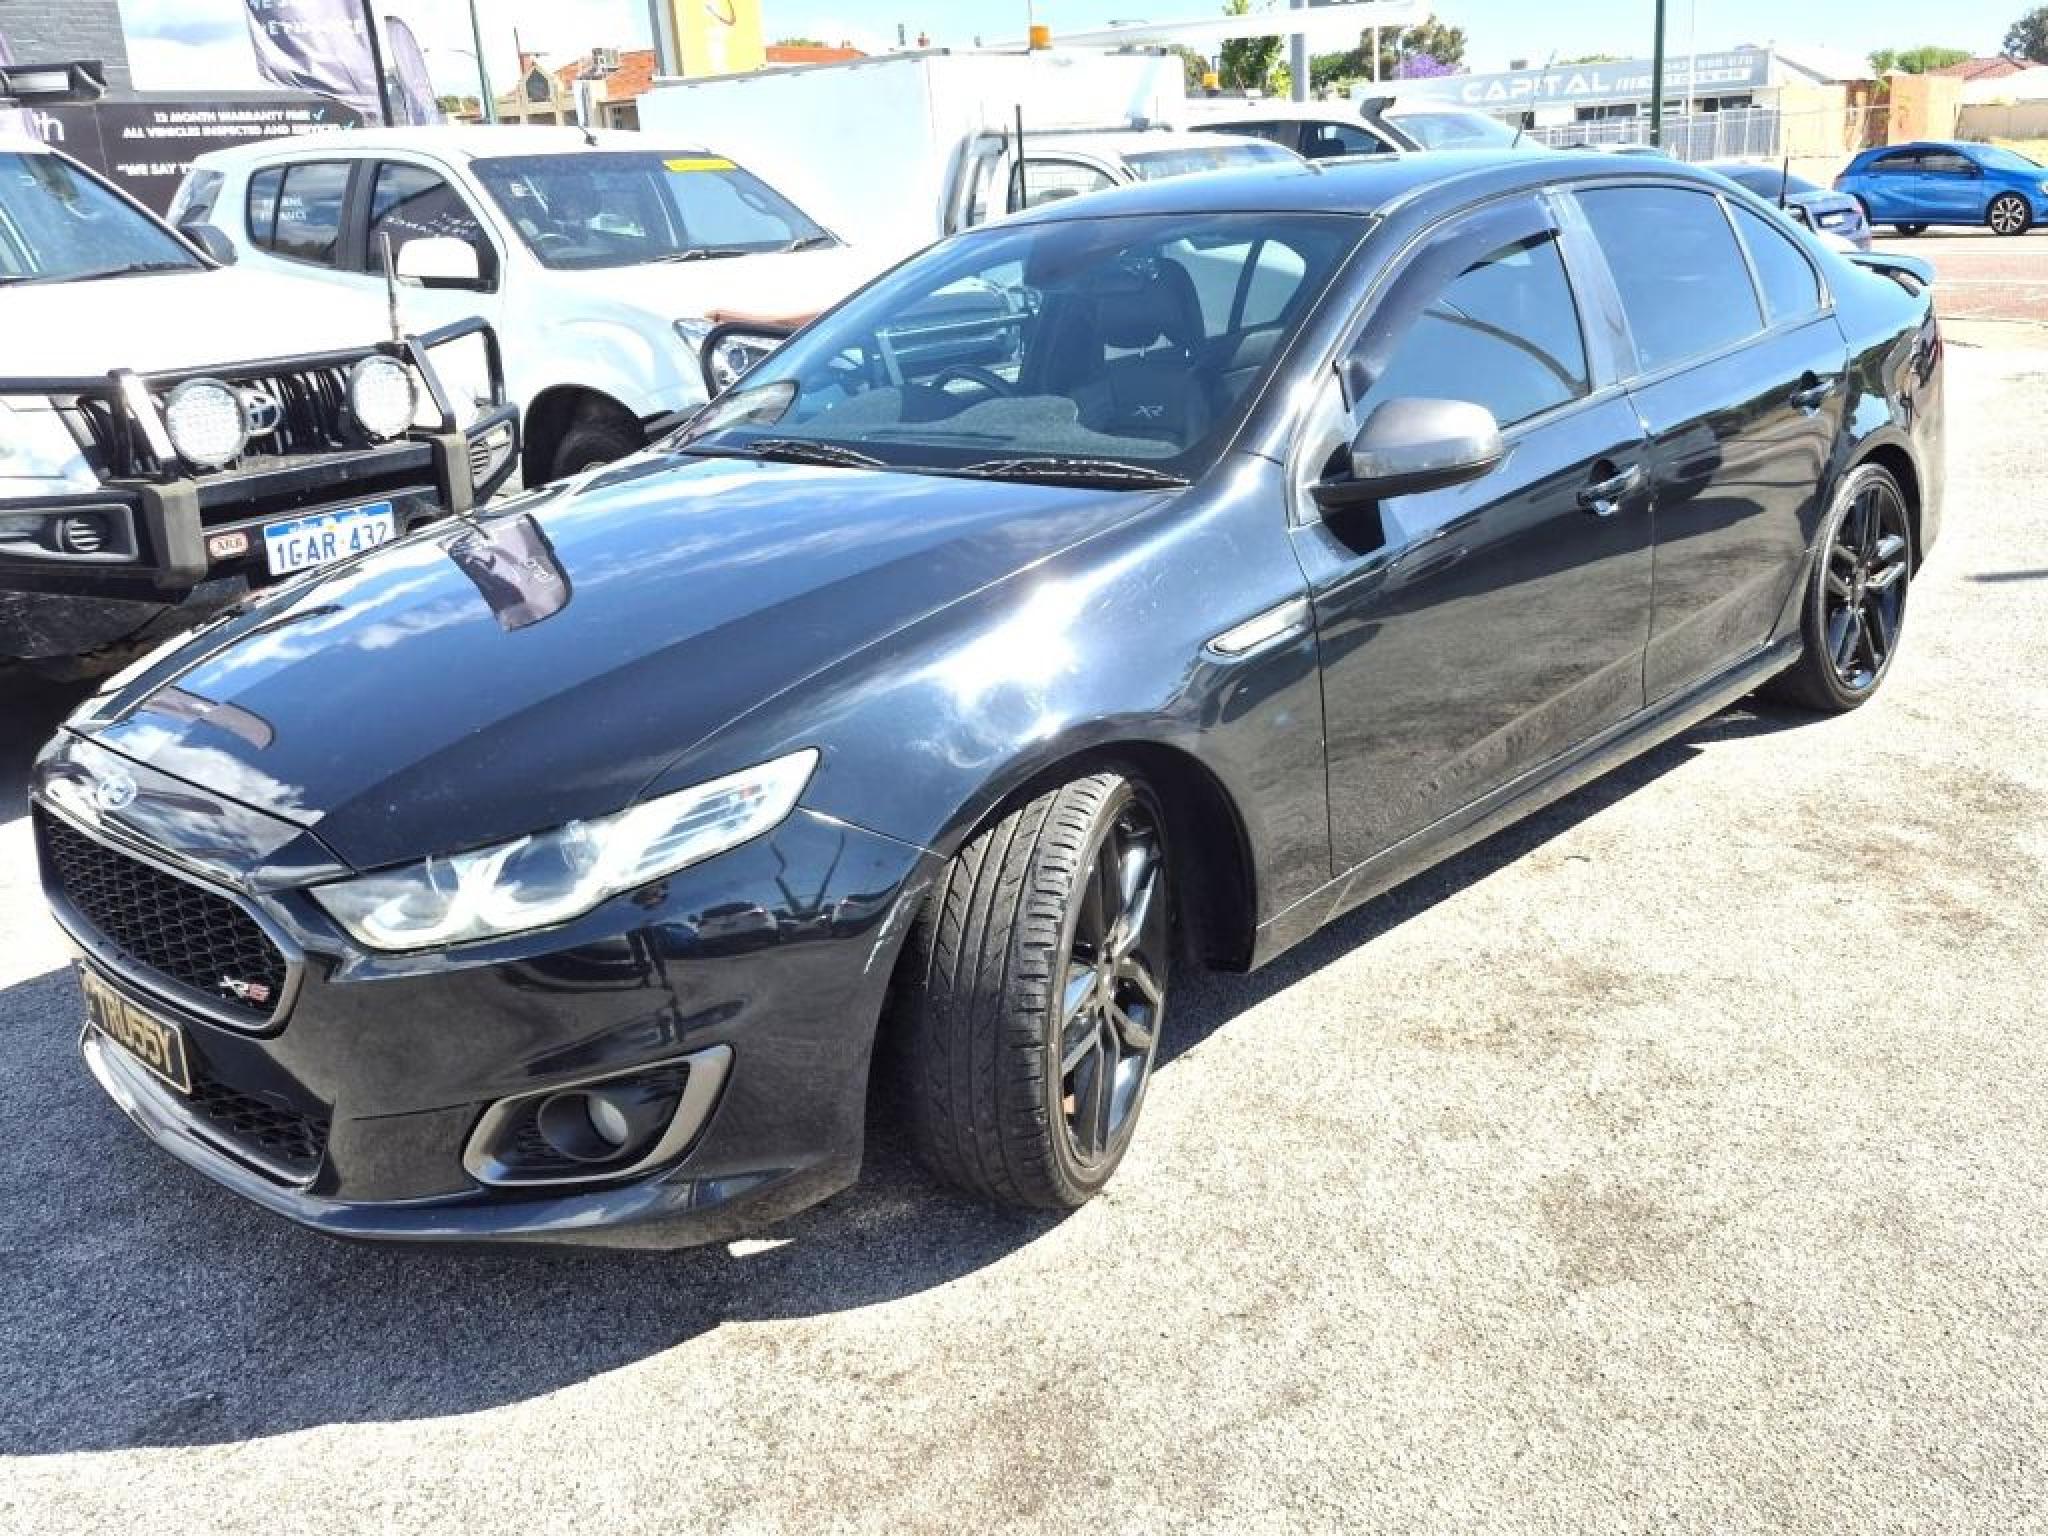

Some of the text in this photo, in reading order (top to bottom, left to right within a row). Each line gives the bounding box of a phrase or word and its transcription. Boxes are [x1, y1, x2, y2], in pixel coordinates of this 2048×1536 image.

[1460, 73, 1610, 102] CAPITAL
[169, 111, 216, 122] MONTH
[218, 111, 283, 121] WARRANTY
[123, 127, 145, 138] ALL
[264, 125, 290, 135] AND
[277, 531, 336, 569] 1GAR
